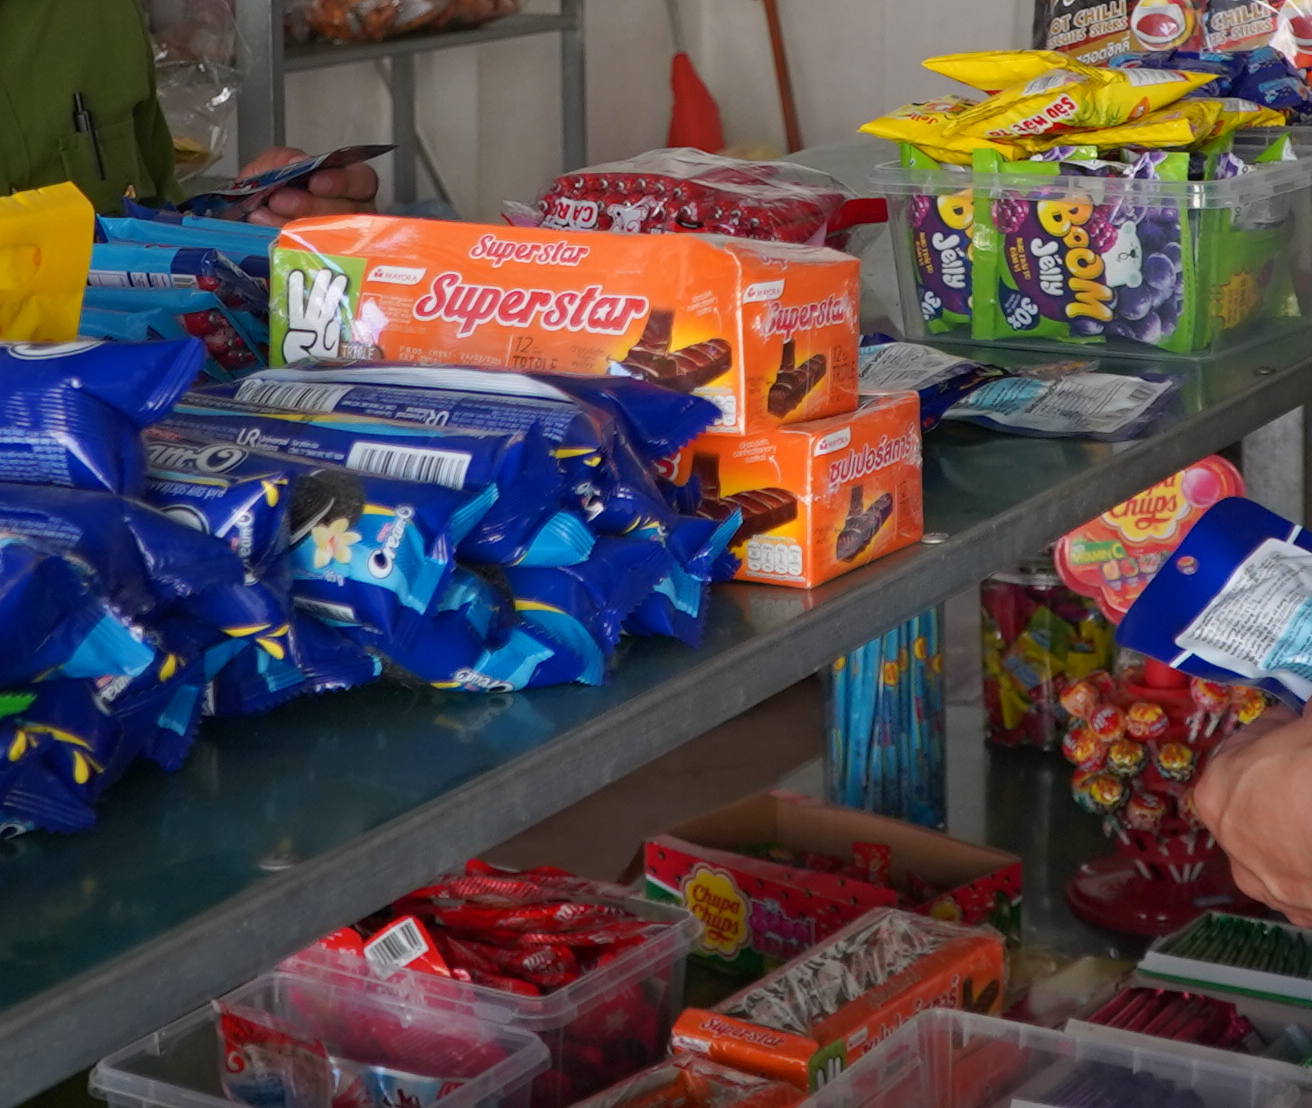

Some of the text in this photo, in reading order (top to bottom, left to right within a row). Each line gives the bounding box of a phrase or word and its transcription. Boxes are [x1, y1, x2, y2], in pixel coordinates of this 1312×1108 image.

[1049, 13, 1071, 36] OT
[1089, 17, 1129, 38] STICKS
[1230, 19, 1274, 40] STICKS
[469, 233, 591, 268] Superstar
[384, 271, 419, 284] MAYORA
[412, 270, 650, 339] Superstar
[515, 335, 534, 354] 12
[237, 427, 261, 447] UR
[691, 882, 741, 915] Chupa
[691, 904, 740, 943] Chups
[699, 1017, 785, 1049] Superstar
